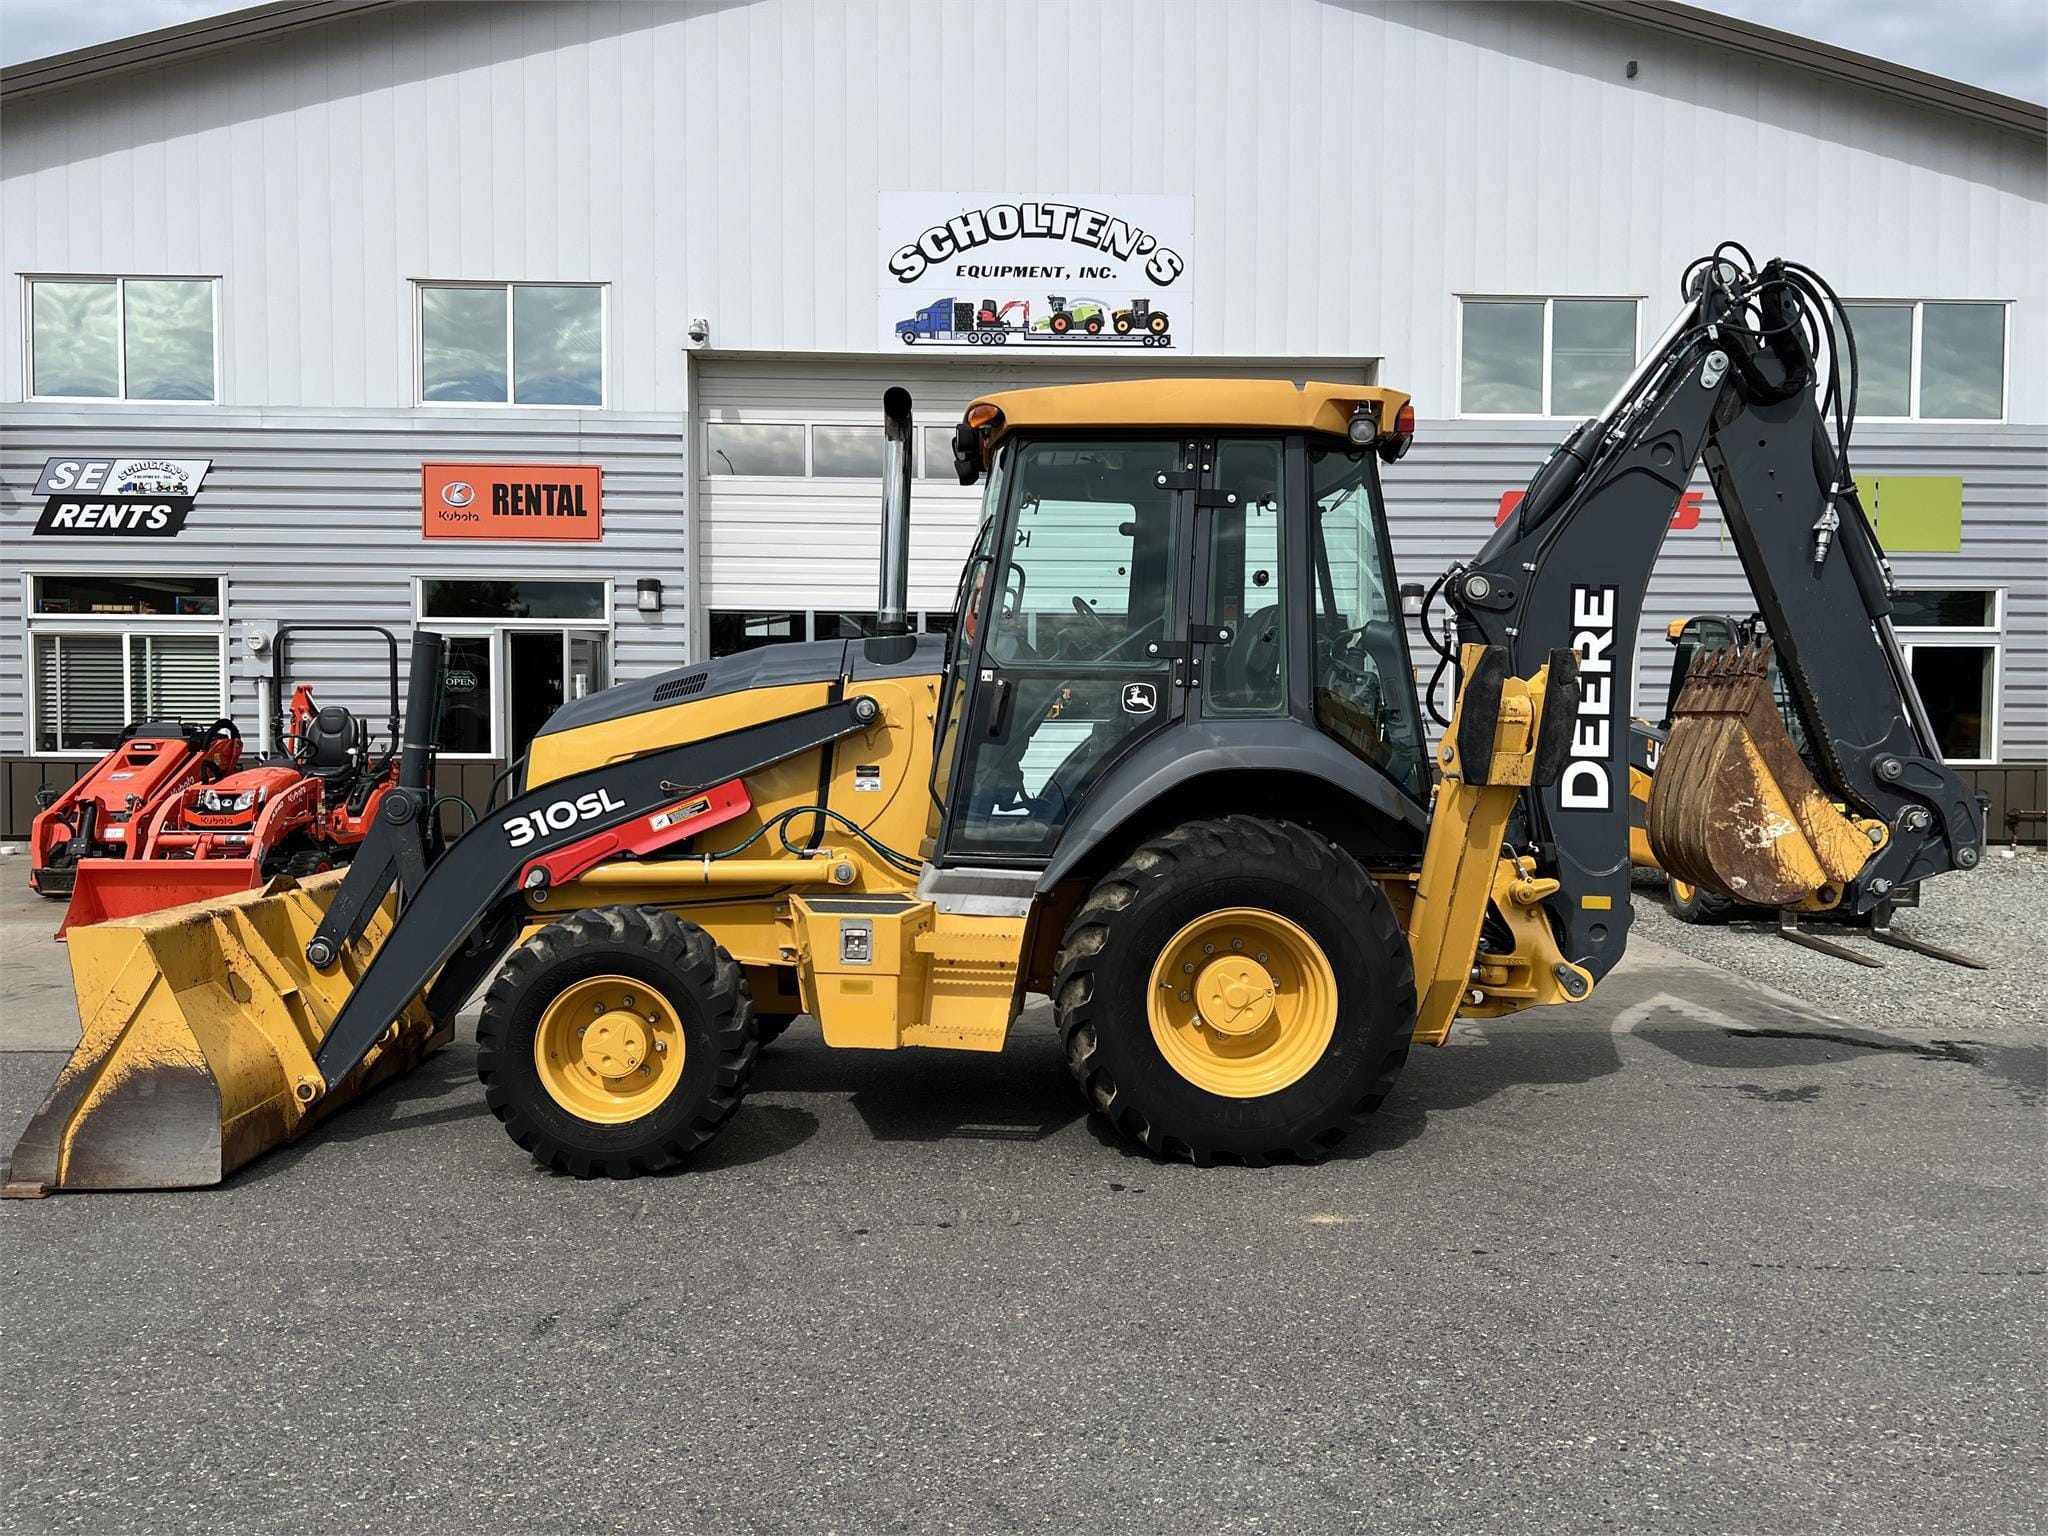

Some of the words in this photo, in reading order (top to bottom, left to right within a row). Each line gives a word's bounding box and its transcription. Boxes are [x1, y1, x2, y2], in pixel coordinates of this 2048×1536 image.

[888, 203, 1184, 287] SCHOLTEN'S
[955, 265, 1071, 280] EQUIPMENT,
[1079, 266, 1118, 279] INC.
[47, 462, 110, 490] SE
[118, 461, 189, 481] SCHOLTEN'S
[492, 483, 587, 517] RENTAL
[50, 503, 172, 529] RENTS
[438, 511, 480, 521] Kubota
[445, 678, 475, 686] OPEN
[1561, 588, 1614, 808] DEERE
[200, 816, 234, 825] Kubota
[503, 788, 626, 848] 310SL
